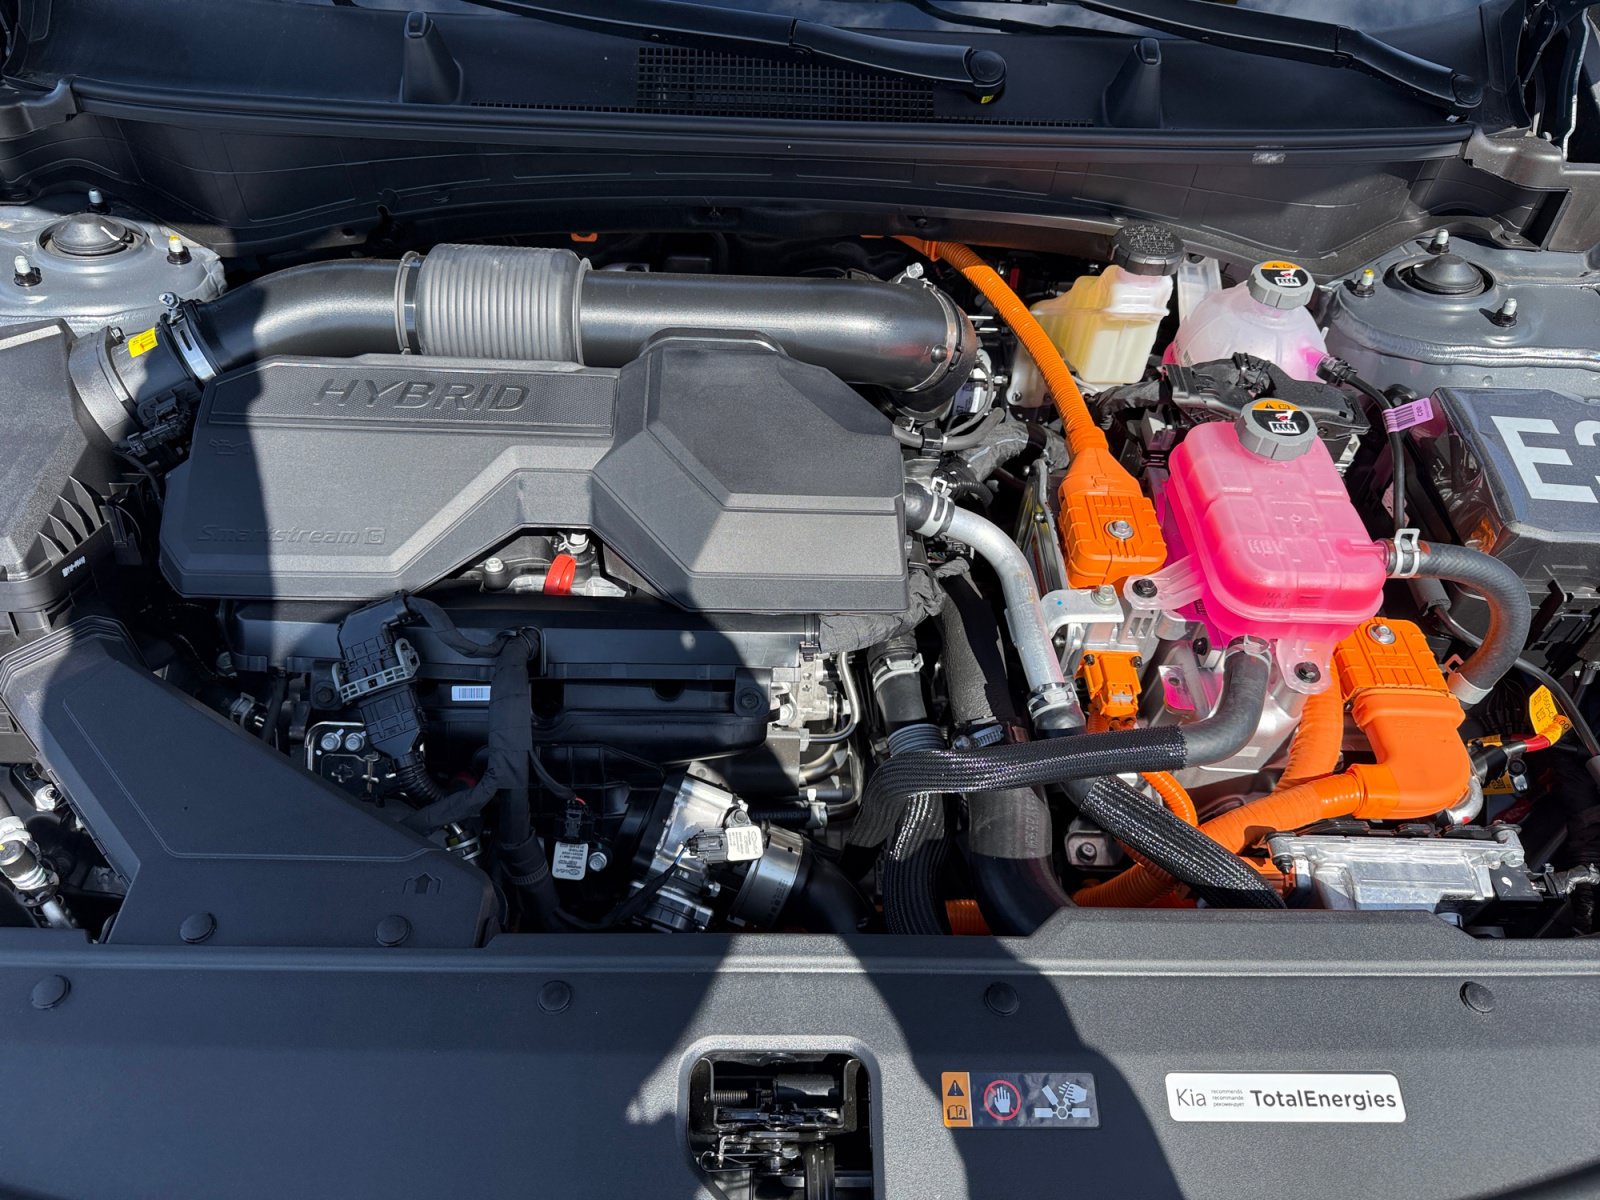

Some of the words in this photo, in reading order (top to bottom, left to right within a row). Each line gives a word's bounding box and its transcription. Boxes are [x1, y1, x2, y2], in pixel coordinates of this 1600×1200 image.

[313, 378, 530, 412] HYBRID
[197, 525, 359, 544] Smartstream
[1265, 592, 1291, 600] MAX
[1176, 1088, 1207, 1107] Kia
[1250, 1090, 1397, 1111] TotalEnergies
